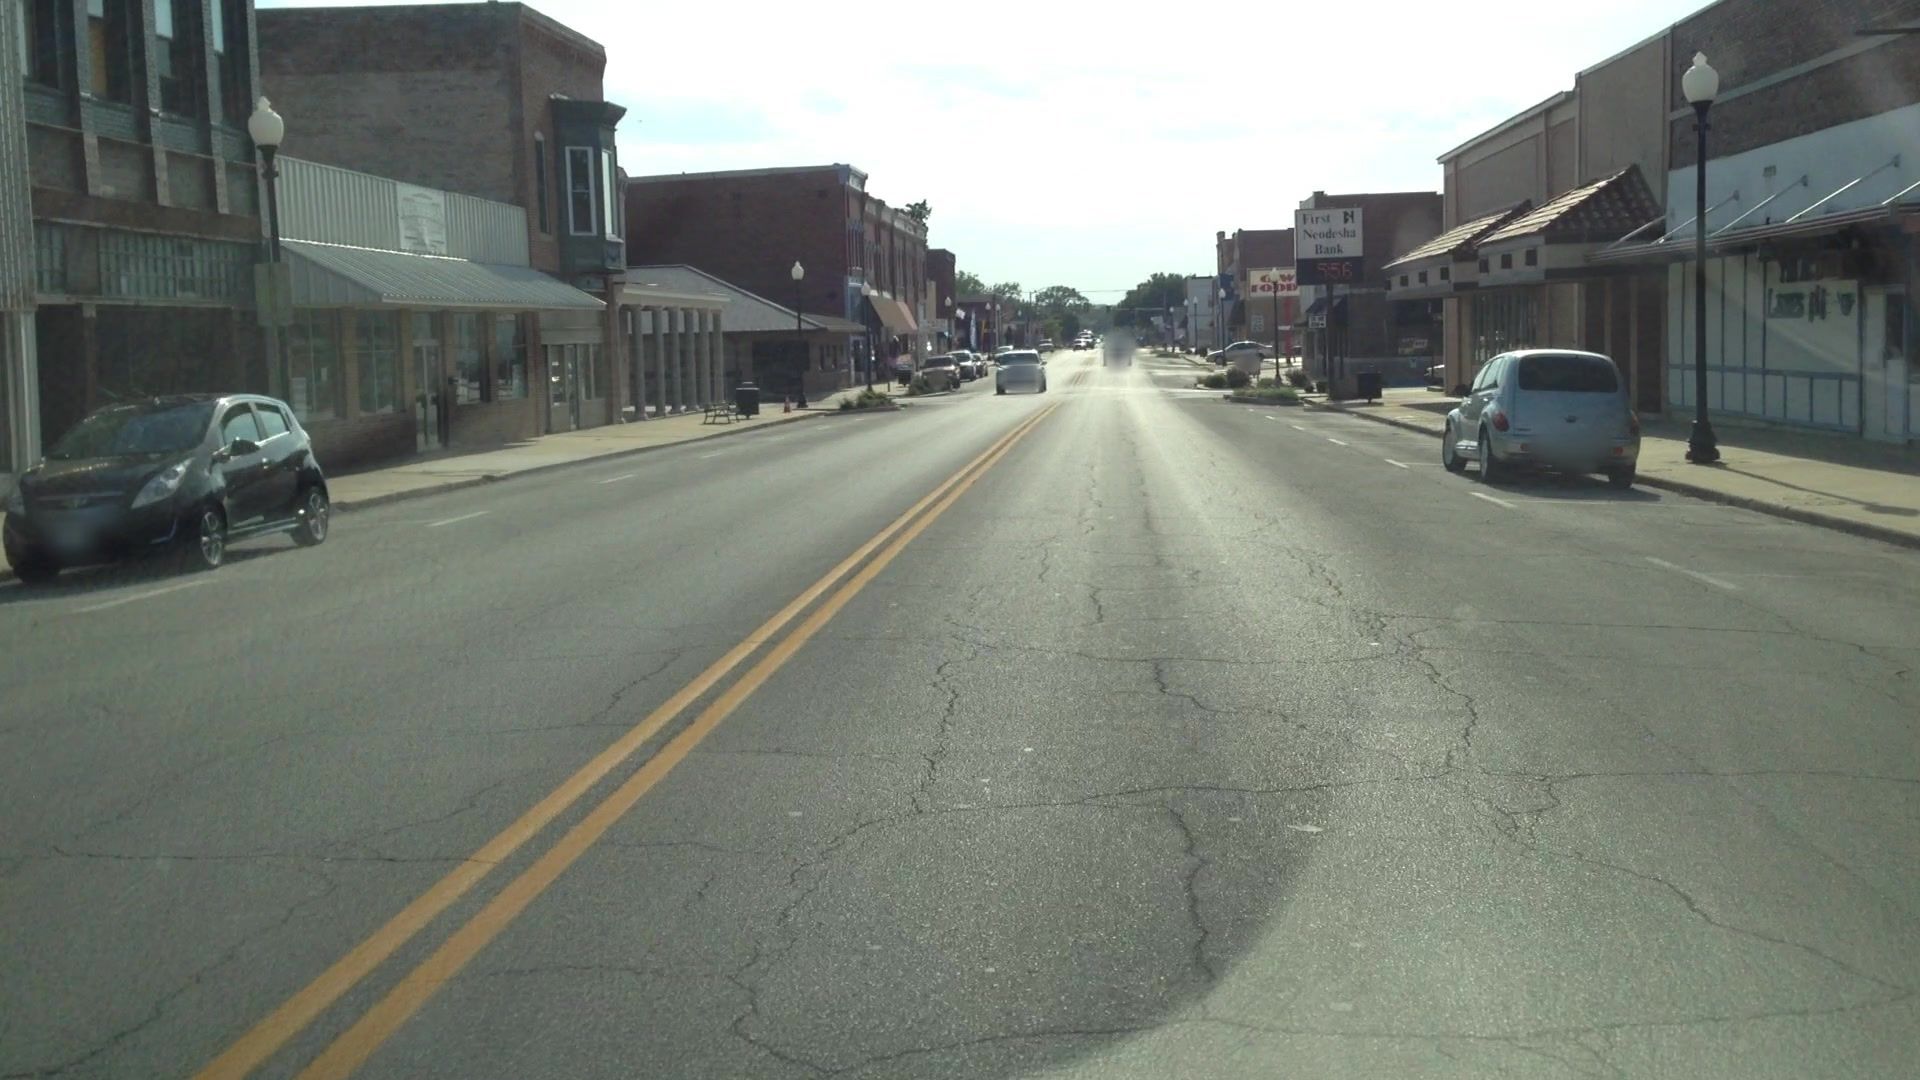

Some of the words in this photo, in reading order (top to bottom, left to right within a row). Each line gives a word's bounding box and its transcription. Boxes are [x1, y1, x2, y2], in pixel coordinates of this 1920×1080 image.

[1302, 213, 1330, 225] First
[1303, 227, 1356, 240] Neodesha
[1315, 243, 1344, 255] Bank
